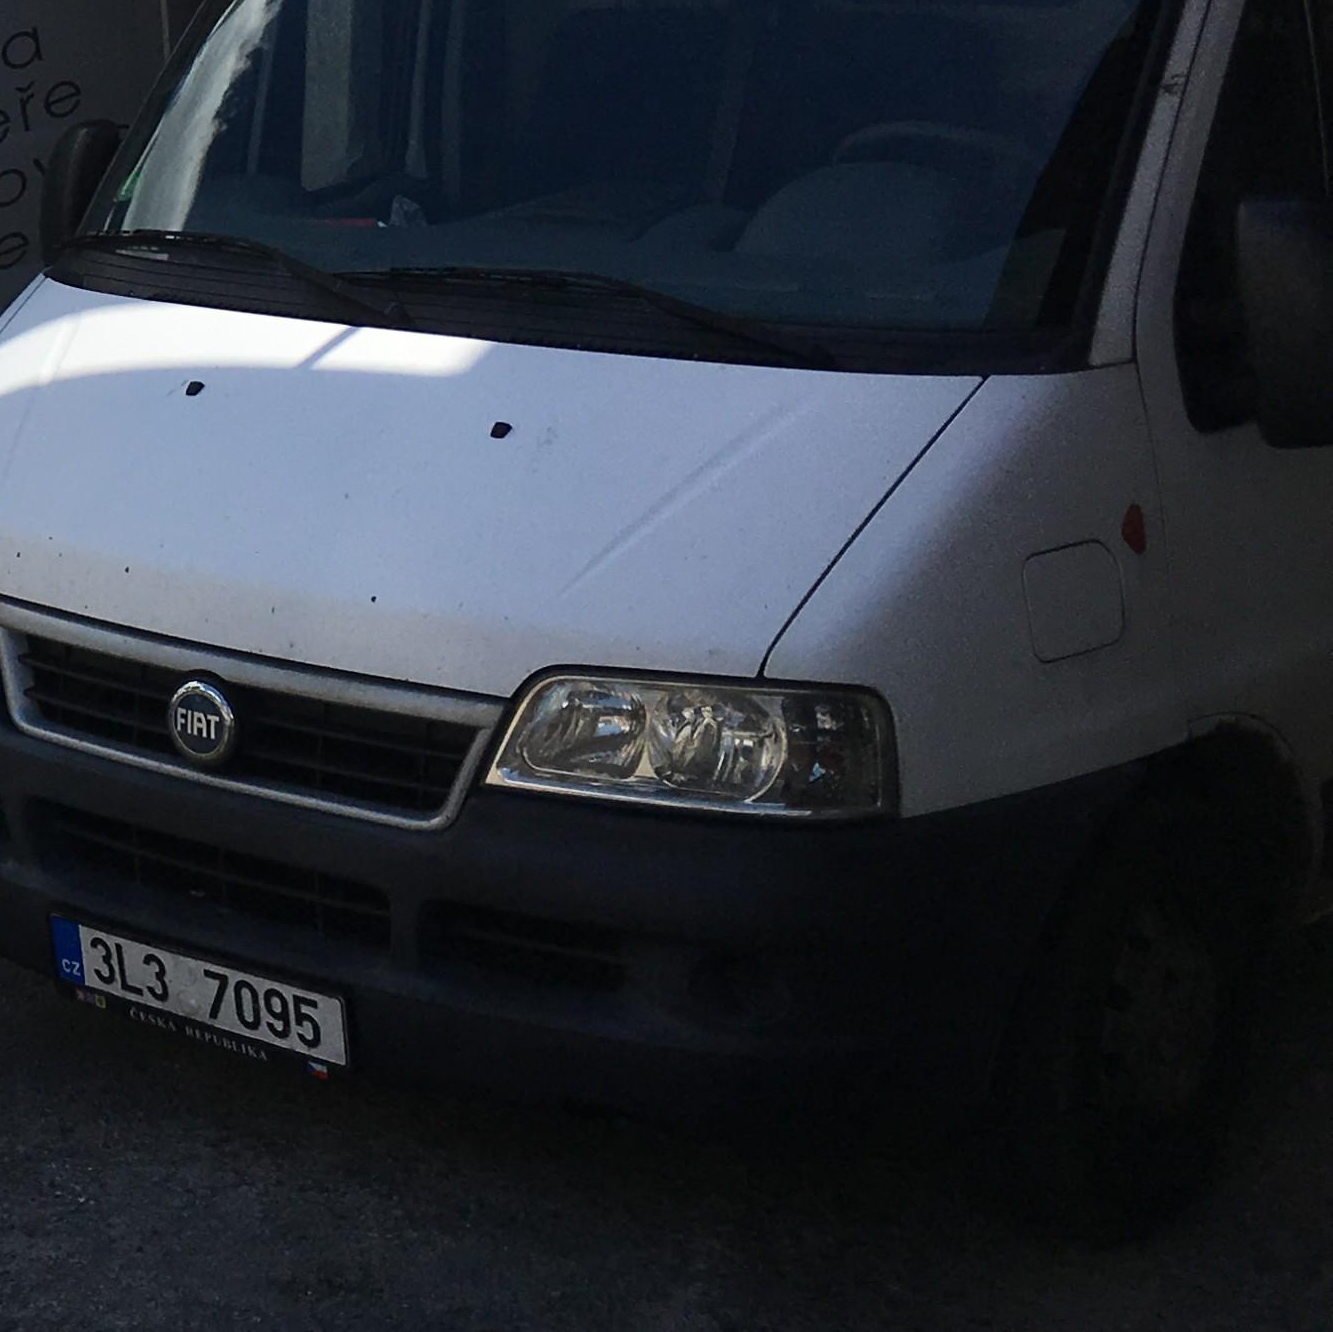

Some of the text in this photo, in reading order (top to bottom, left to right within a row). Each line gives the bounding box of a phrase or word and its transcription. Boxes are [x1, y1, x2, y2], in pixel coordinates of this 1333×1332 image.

[176, 706, 220, 741] FIAT
[61, 957, 81, 977] CZ
[89, 936, 322, 1050] 3L3 7095
[184, 1025, 269, 1061] REPUBLIKA
